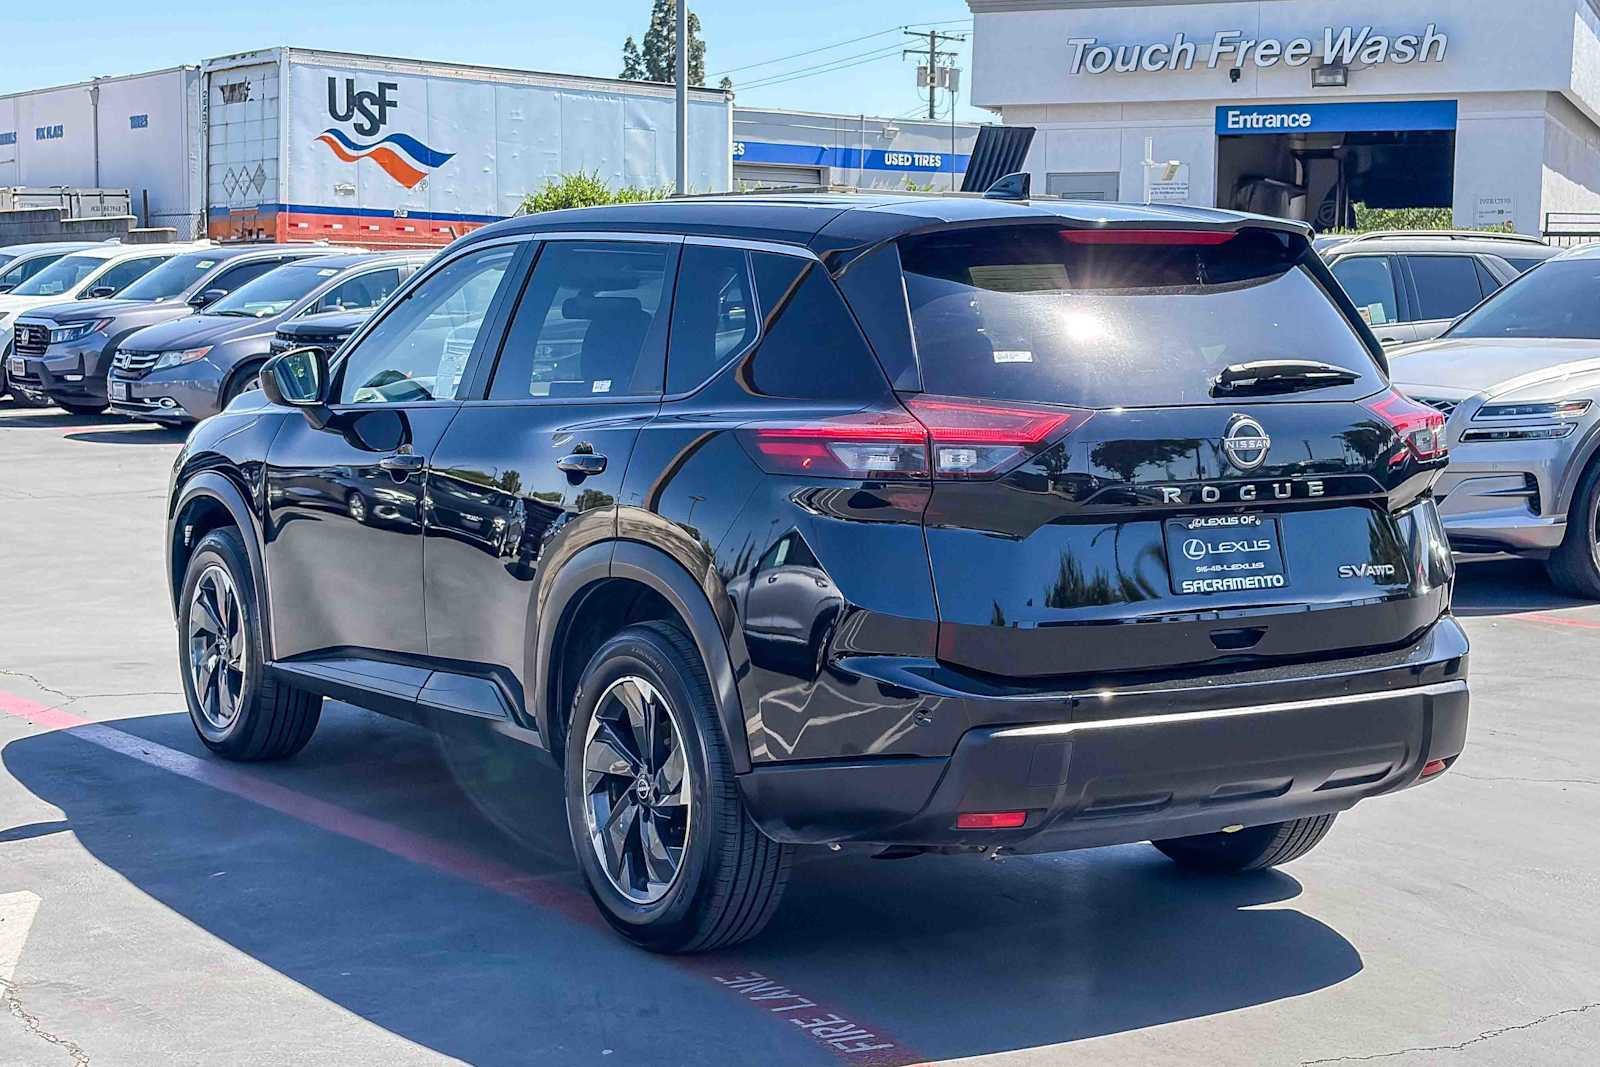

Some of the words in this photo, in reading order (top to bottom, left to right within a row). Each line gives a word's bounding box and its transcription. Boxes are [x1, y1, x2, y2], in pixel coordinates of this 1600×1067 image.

[1066, 33, 1195, 75] Touch
[1208, 29, 1316, 69] Free
[1322, 23, 1448, 65] Wash
[328, 77, 398, 136] USF
[1226, 109, 1312, 130] Entrance
[884, 153, 912, 167] USED
[914, 154, 942, 168] TIRES
[1225, 439, 1270, 449] NISSAN
[1162, 481, 1326, 505] ROGUE
[1202, 517, 1238, 526] LEXUS
[1241, 515, 1256, 525] OF
[1208, 539, 1272, 554] LEXUS
[1182, 574, 1284, 593] SACRAMENTO
[712, 971, 817, 1013] LANE
[789, 1013, 894, 1053] FIRE
